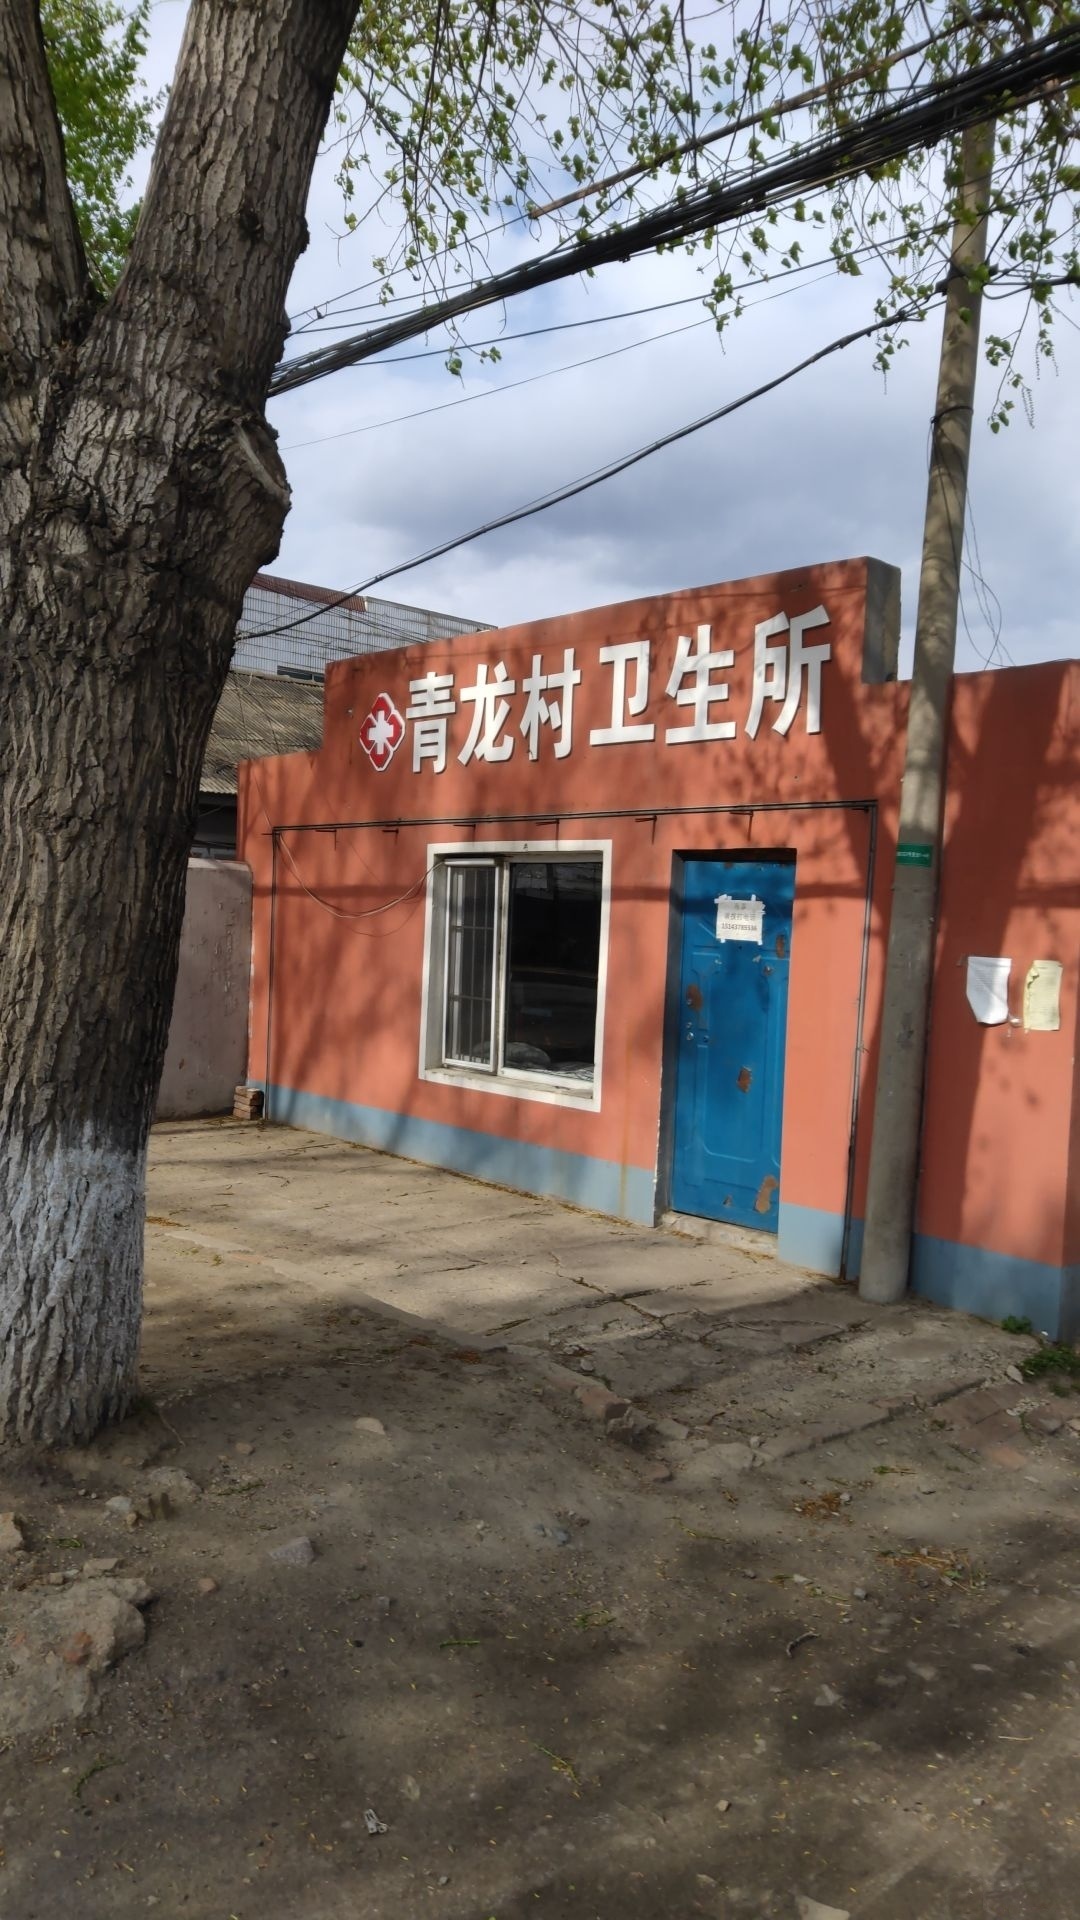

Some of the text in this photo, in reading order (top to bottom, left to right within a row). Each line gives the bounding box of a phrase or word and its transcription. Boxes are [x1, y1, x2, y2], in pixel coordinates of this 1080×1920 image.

[405, 605, 831, 773] 青龙村卫生所
